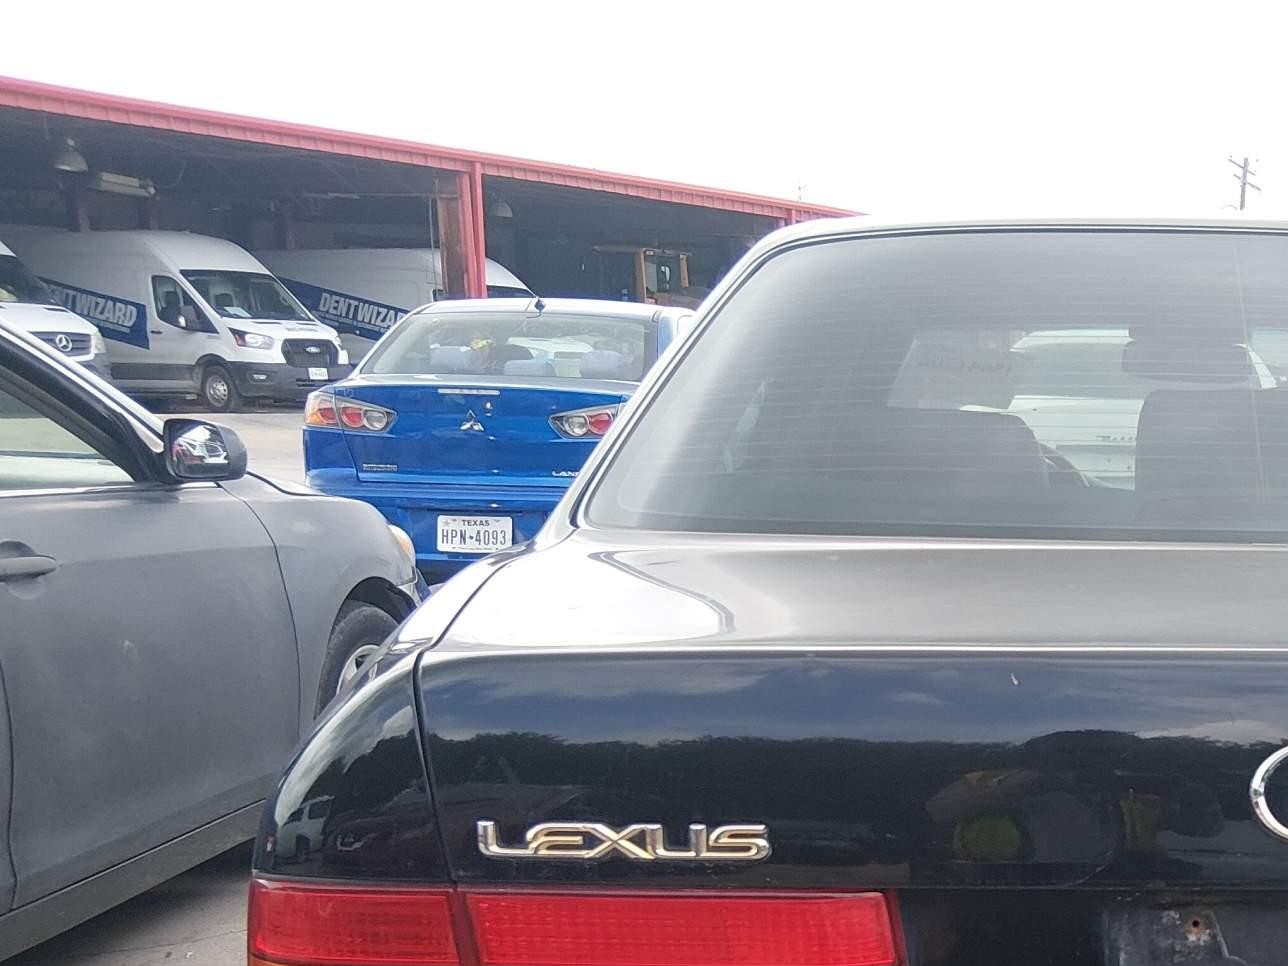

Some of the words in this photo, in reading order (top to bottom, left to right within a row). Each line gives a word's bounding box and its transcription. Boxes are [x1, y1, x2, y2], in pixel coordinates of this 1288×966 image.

[76, 292, 137, 327] WIZARD
[319, 292, 359, 319] DENT
[462, 519, 490, 527] TEXAS
[477, 820, 772, 860] LEXUS
